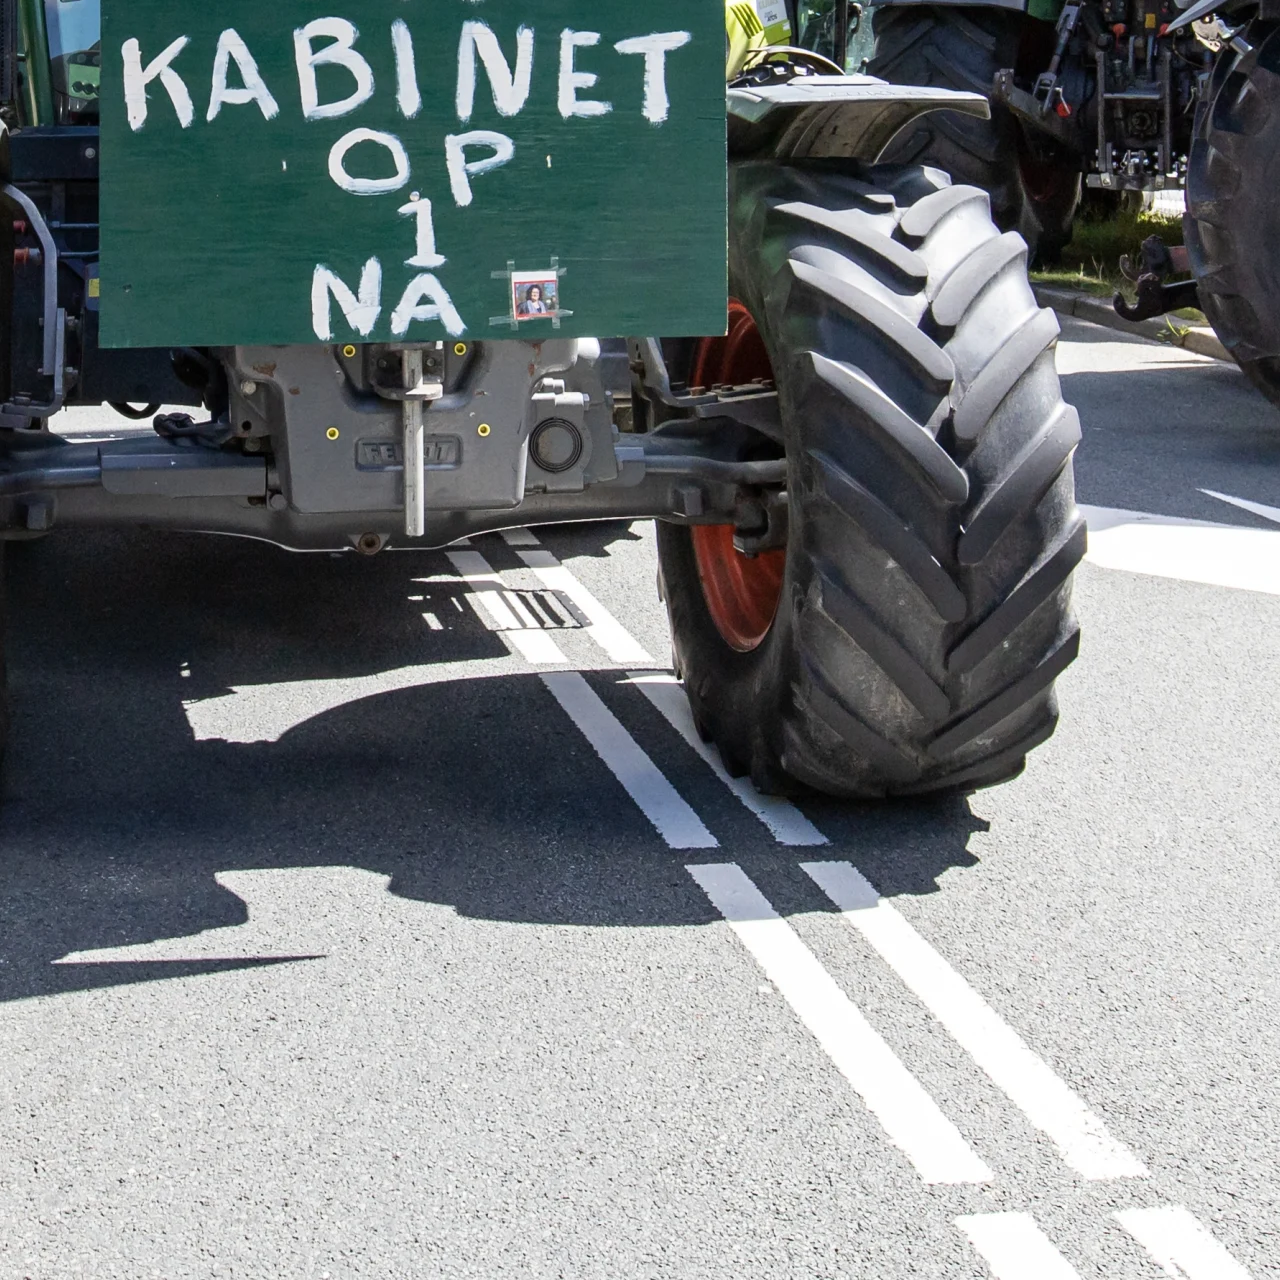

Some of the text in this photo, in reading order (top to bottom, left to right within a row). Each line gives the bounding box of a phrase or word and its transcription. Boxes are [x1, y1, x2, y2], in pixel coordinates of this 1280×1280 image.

[120, 16, 692, 132] KABINET
[327, 127, 516, 207] OP
[397, 194, 447, 268] 1
[310, 256, 469, 341] NA
